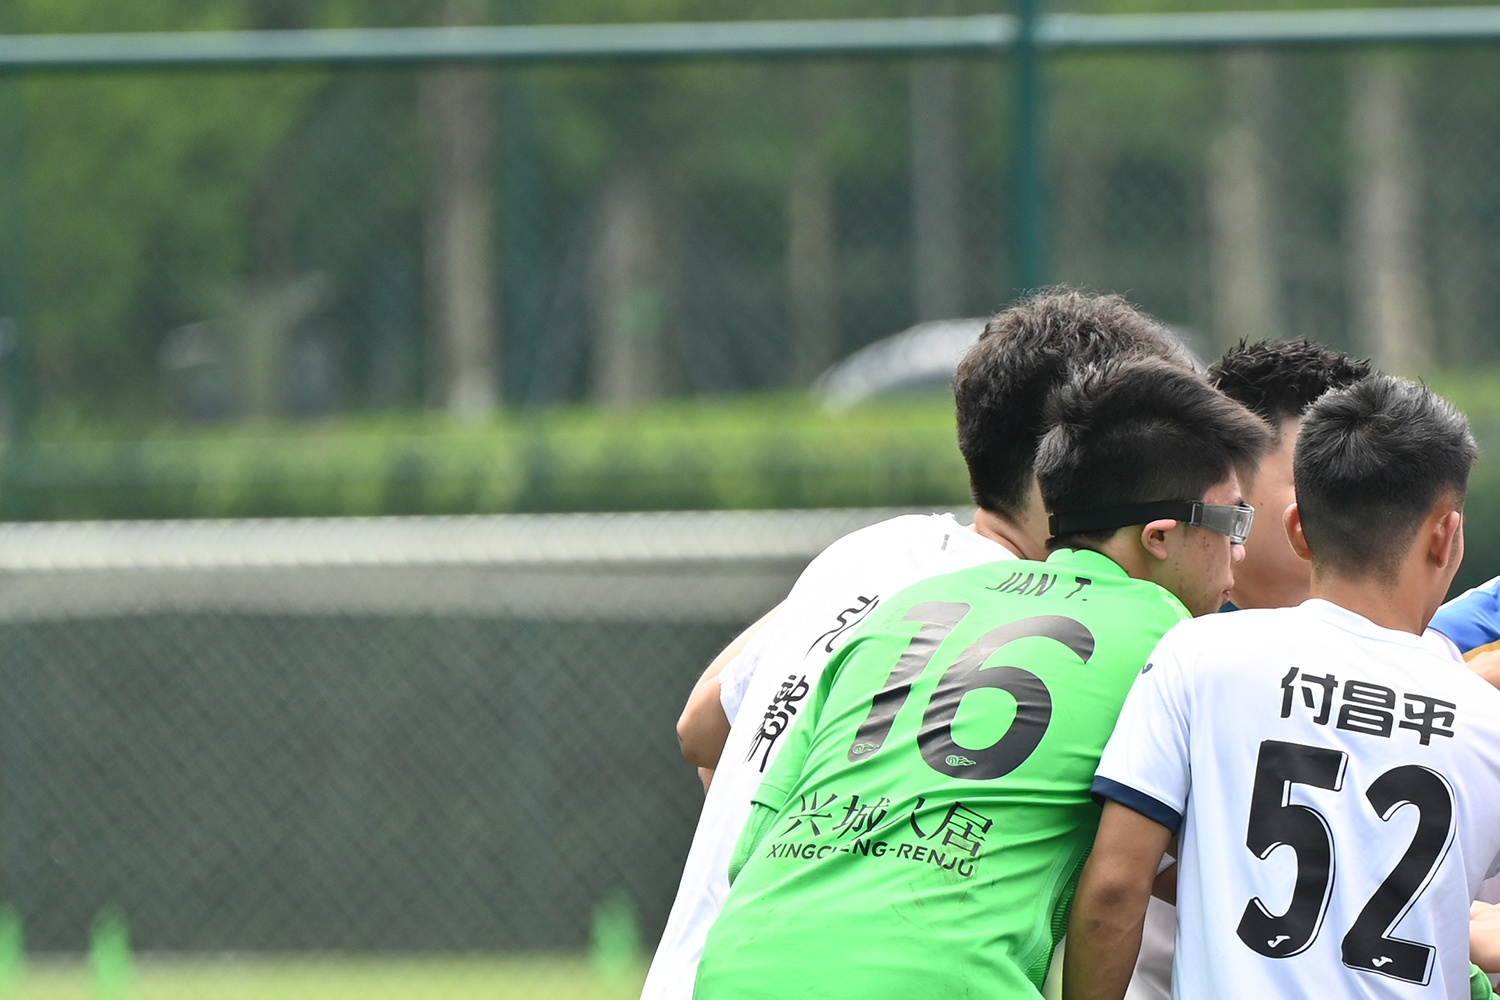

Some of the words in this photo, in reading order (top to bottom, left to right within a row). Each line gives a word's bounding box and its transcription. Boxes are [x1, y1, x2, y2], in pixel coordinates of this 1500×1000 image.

[985, 571, 1058, 597] JIAN
[1064, 576, 1092, 602] T.
[846, 601, 1096, 781] 16
[1280, 666, 1457, 746] 付昌平
[766, 837, 975, 878] XINGCNG-RENJU
[779, 791, 994, 858] 兴城人居
[1236, 739, 1456, 987] 52
